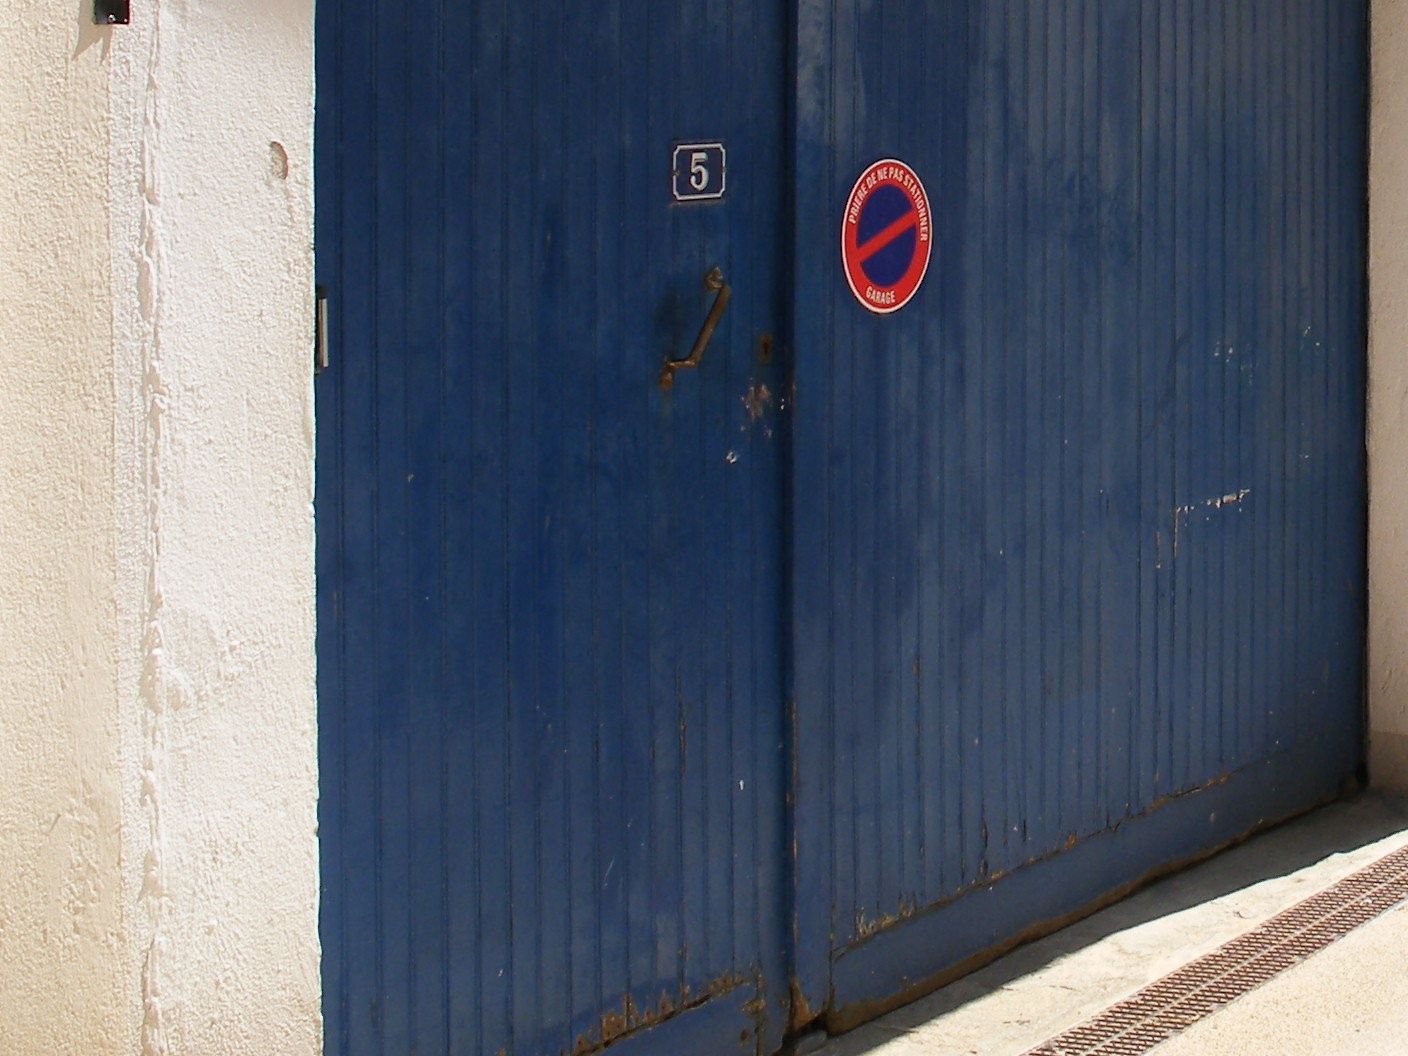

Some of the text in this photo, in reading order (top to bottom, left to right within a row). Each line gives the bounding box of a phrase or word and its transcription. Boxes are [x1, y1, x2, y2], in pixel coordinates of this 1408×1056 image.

[689, 151, 710, 192] 5
[866, 172, 878, 190] DE
[876, 166, 888, 181] NE
[888, 166, 905, 183] PAS
[903, 173, 929, 242] STATIONNER
[865, 286, 896, 305] GARAGE
